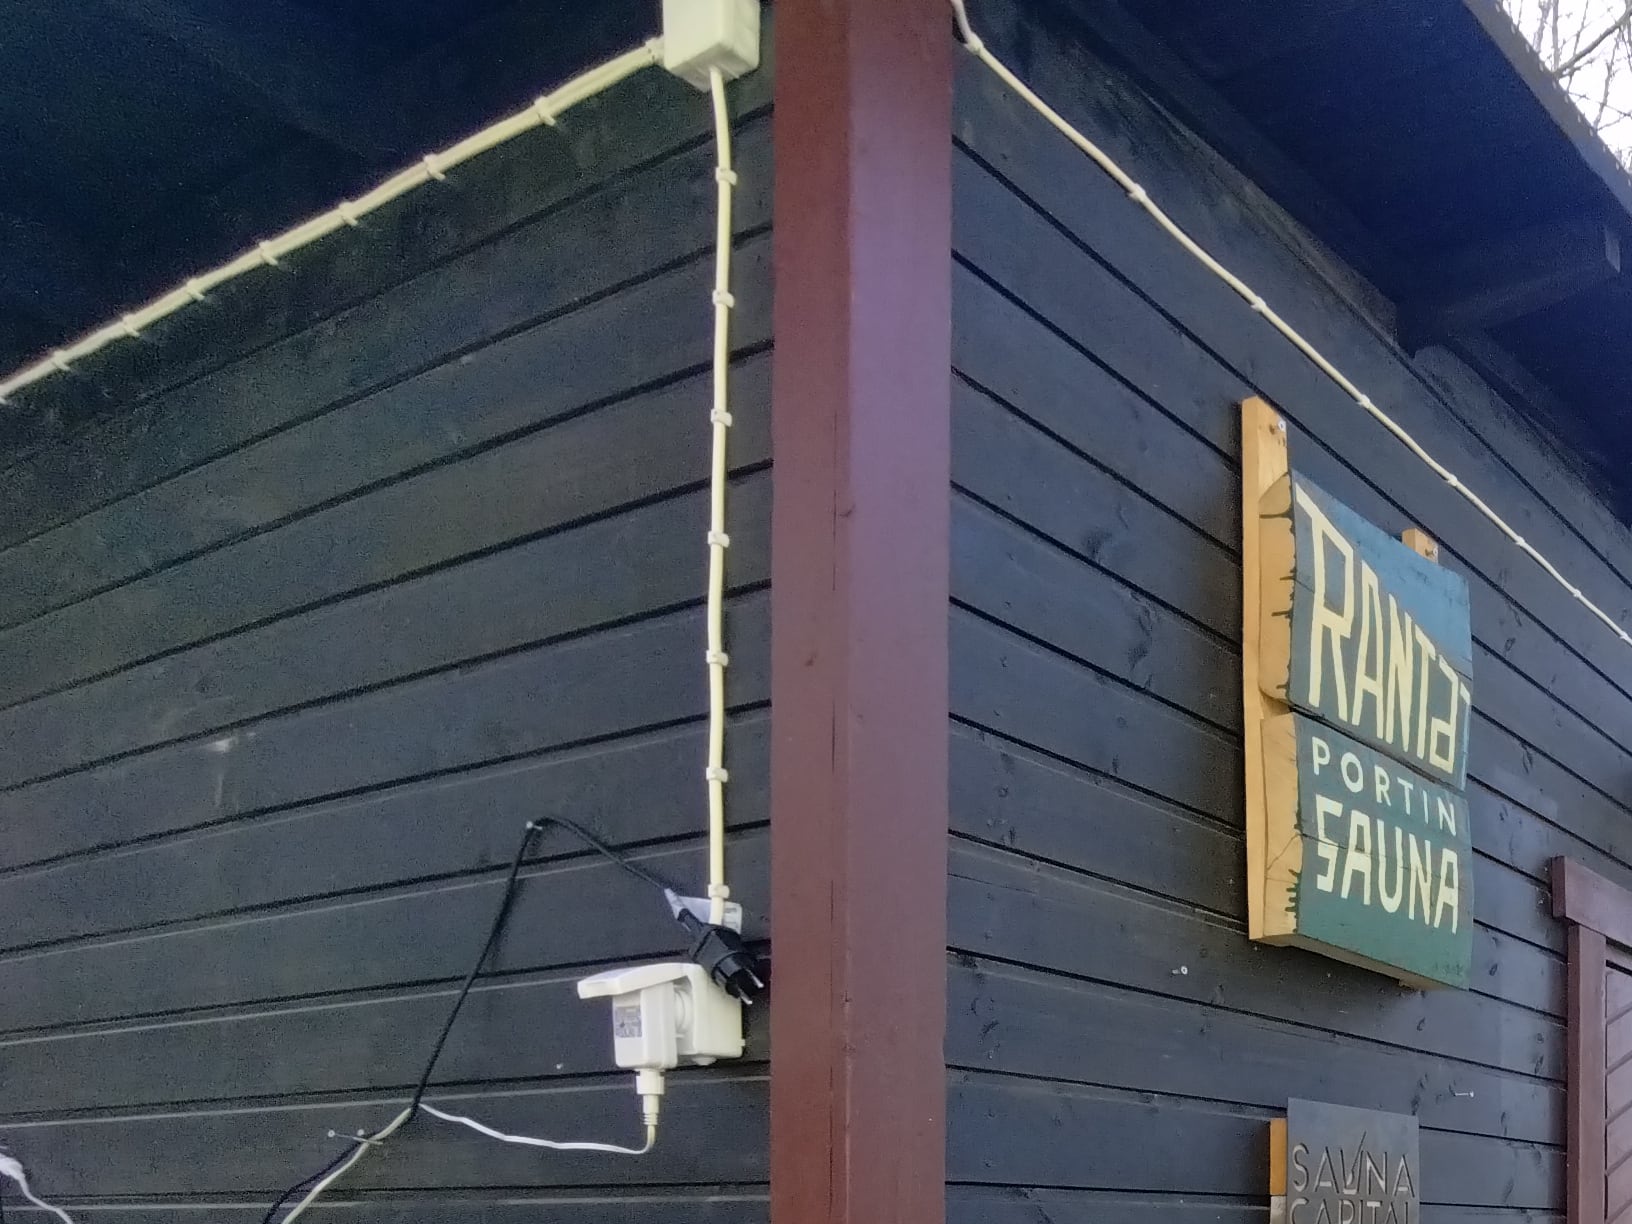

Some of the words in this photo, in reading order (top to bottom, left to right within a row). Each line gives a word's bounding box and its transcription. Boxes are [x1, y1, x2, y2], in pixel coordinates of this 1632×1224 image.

[1312, 736, 1456, 836] PORTIN
[1315, 793, 1459, 934] SAUNA
[1292, 1141, 1415, 1198] SAUNA
